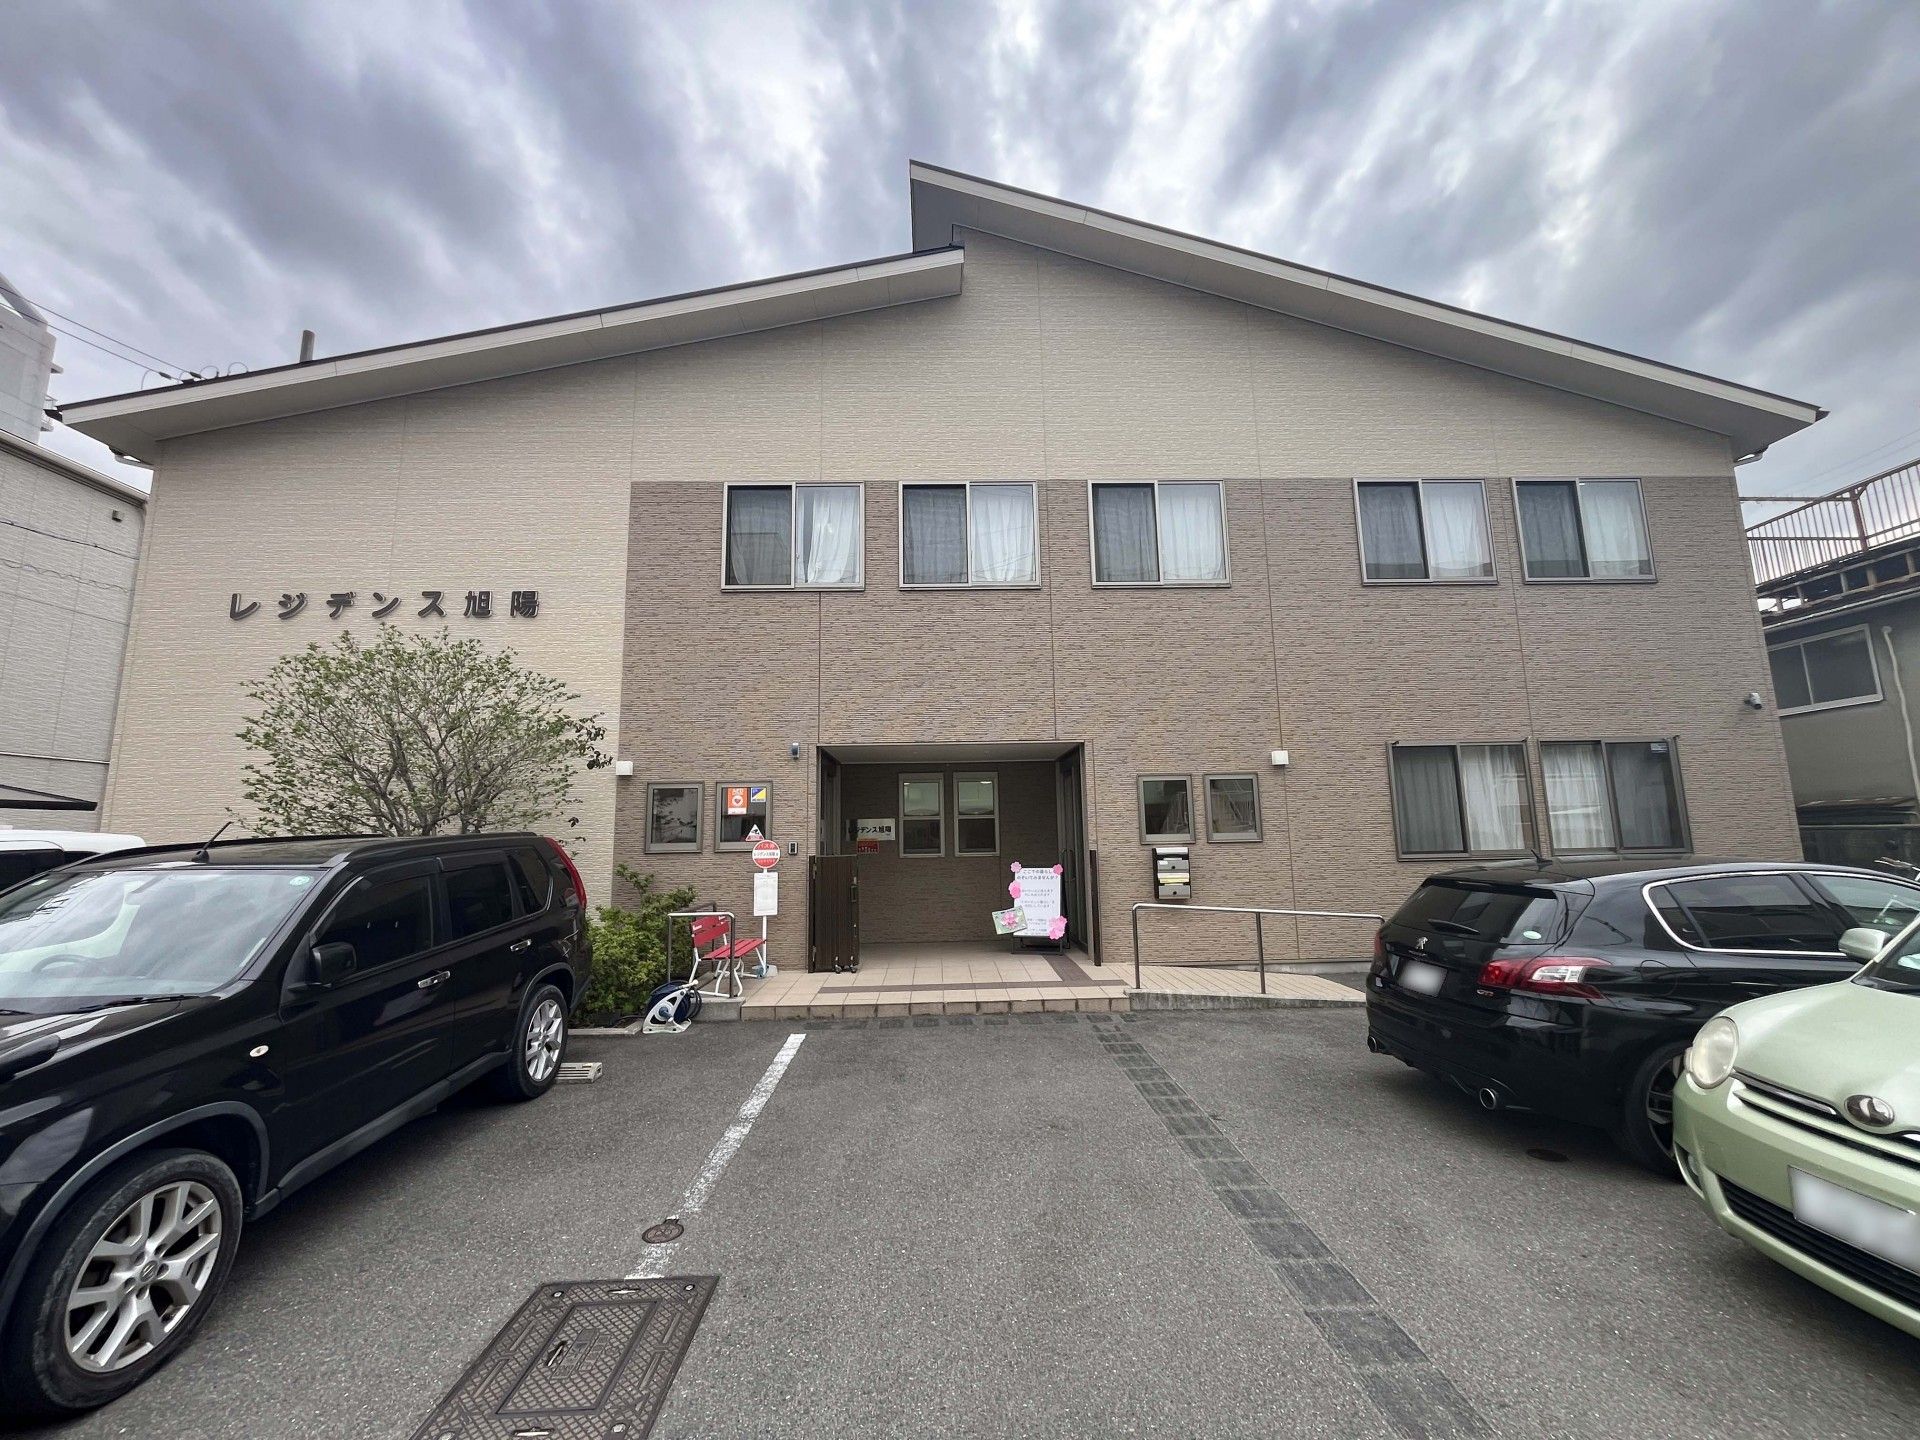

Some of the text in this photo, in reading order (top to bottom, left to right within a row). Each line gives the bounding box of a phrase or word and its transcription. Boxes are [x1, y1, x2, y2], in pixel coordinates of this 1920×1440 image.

[229, 590, 540, 621] レジデンス旭陽
